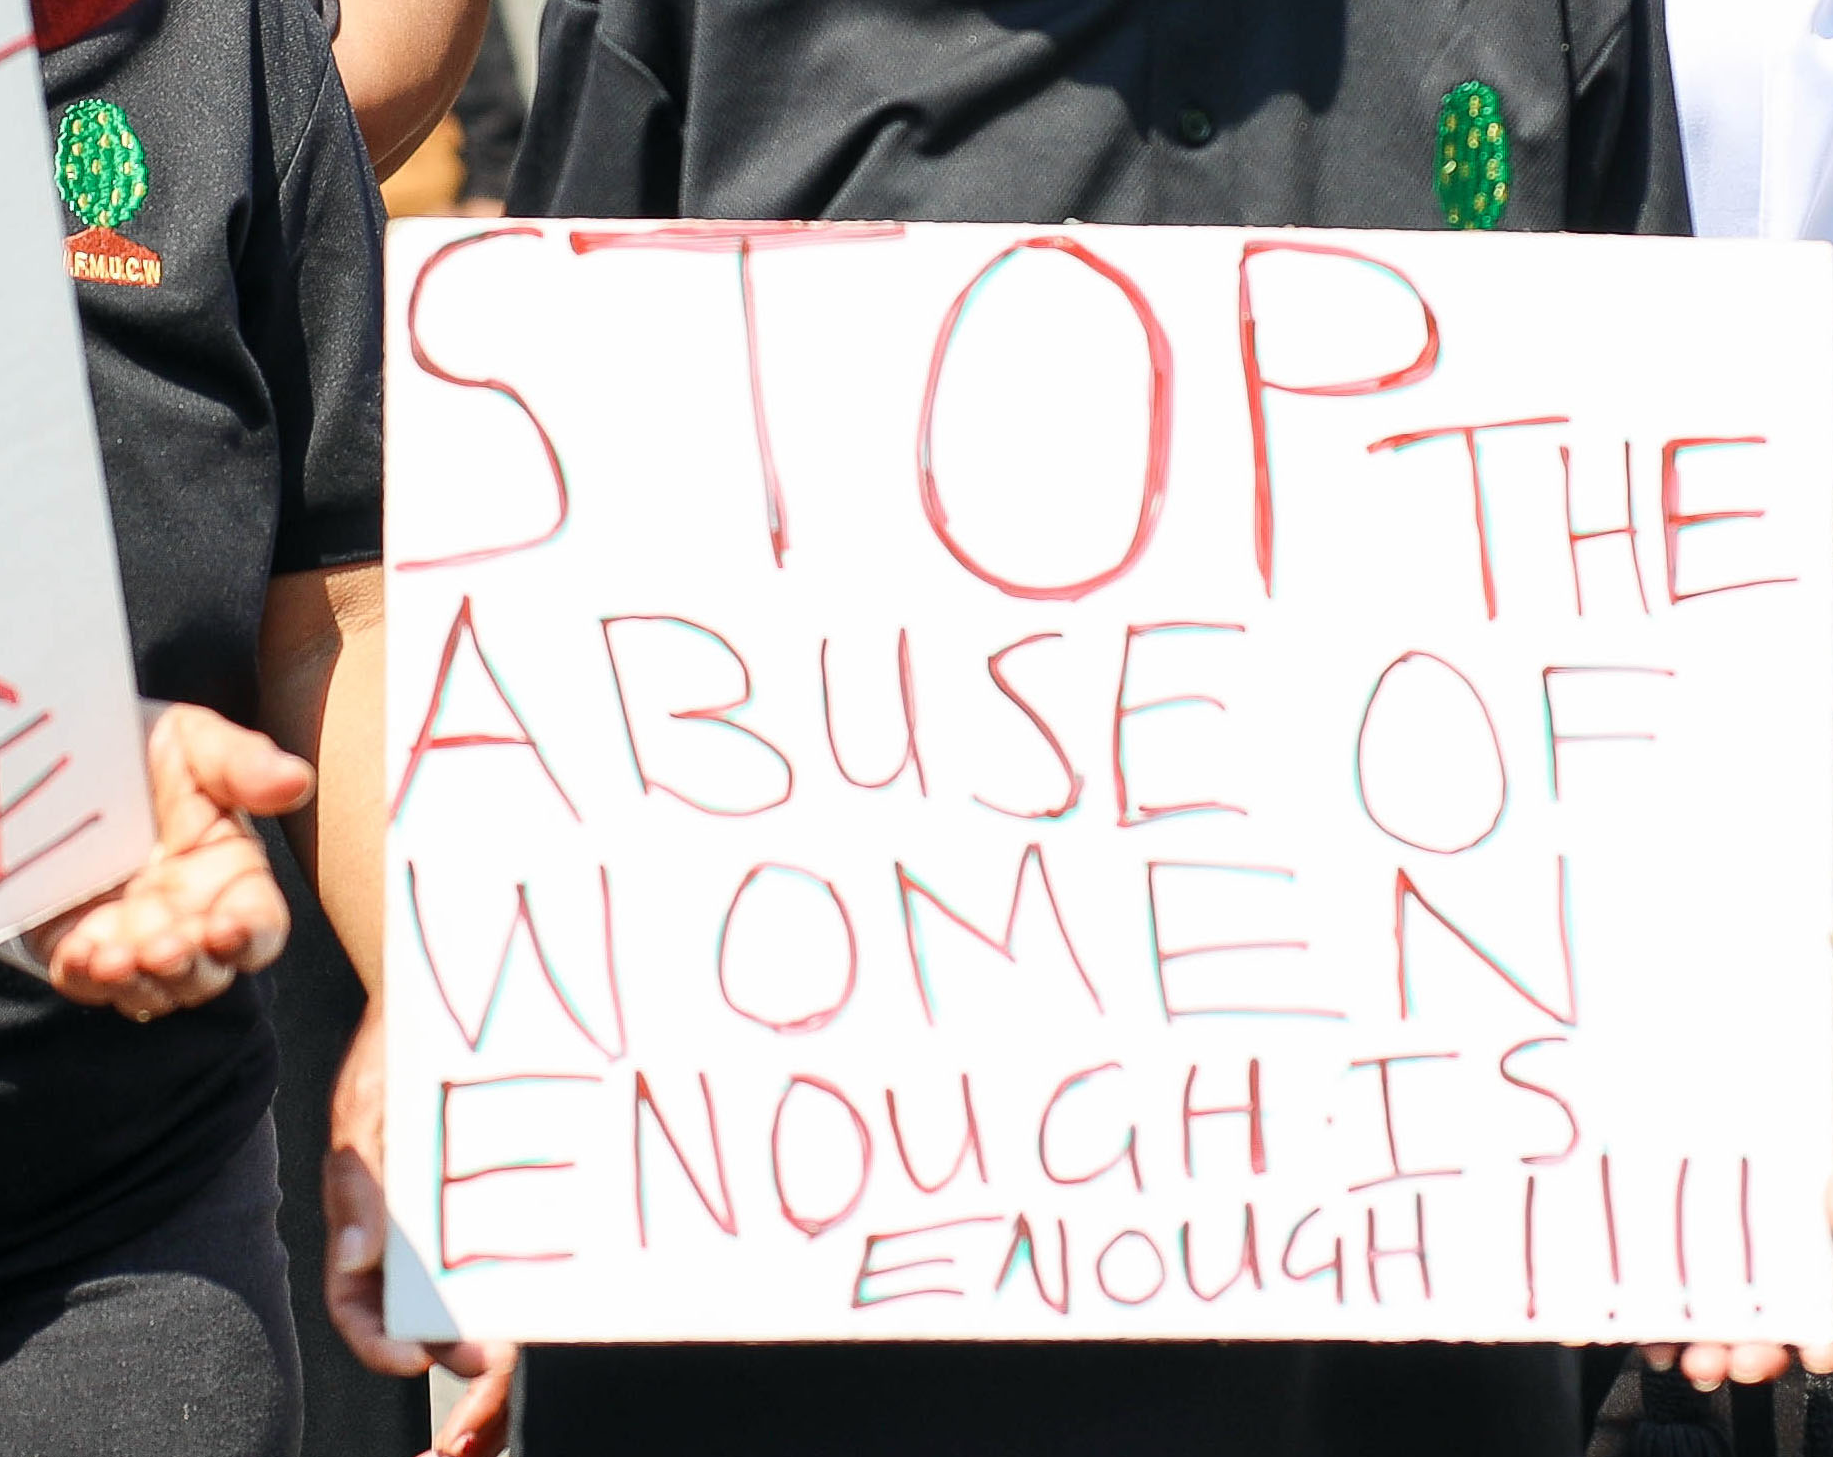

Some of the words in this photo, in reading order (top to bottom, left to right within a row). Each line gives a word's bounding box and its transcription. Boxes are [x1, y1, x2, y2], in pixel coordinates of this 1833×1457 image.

[393, 226, 1442, 600] STOP
[1367, 416, 1798, 619] THE
[388, 596, 1248, 828] ABUSE
[1355, 651, 1675, 853] OF
[407, 843, 1577, 1060] WOMEN
[441, 1059, 1266, 1271] ENOUGH
[1348, 1037, 1579, 1191] IS
